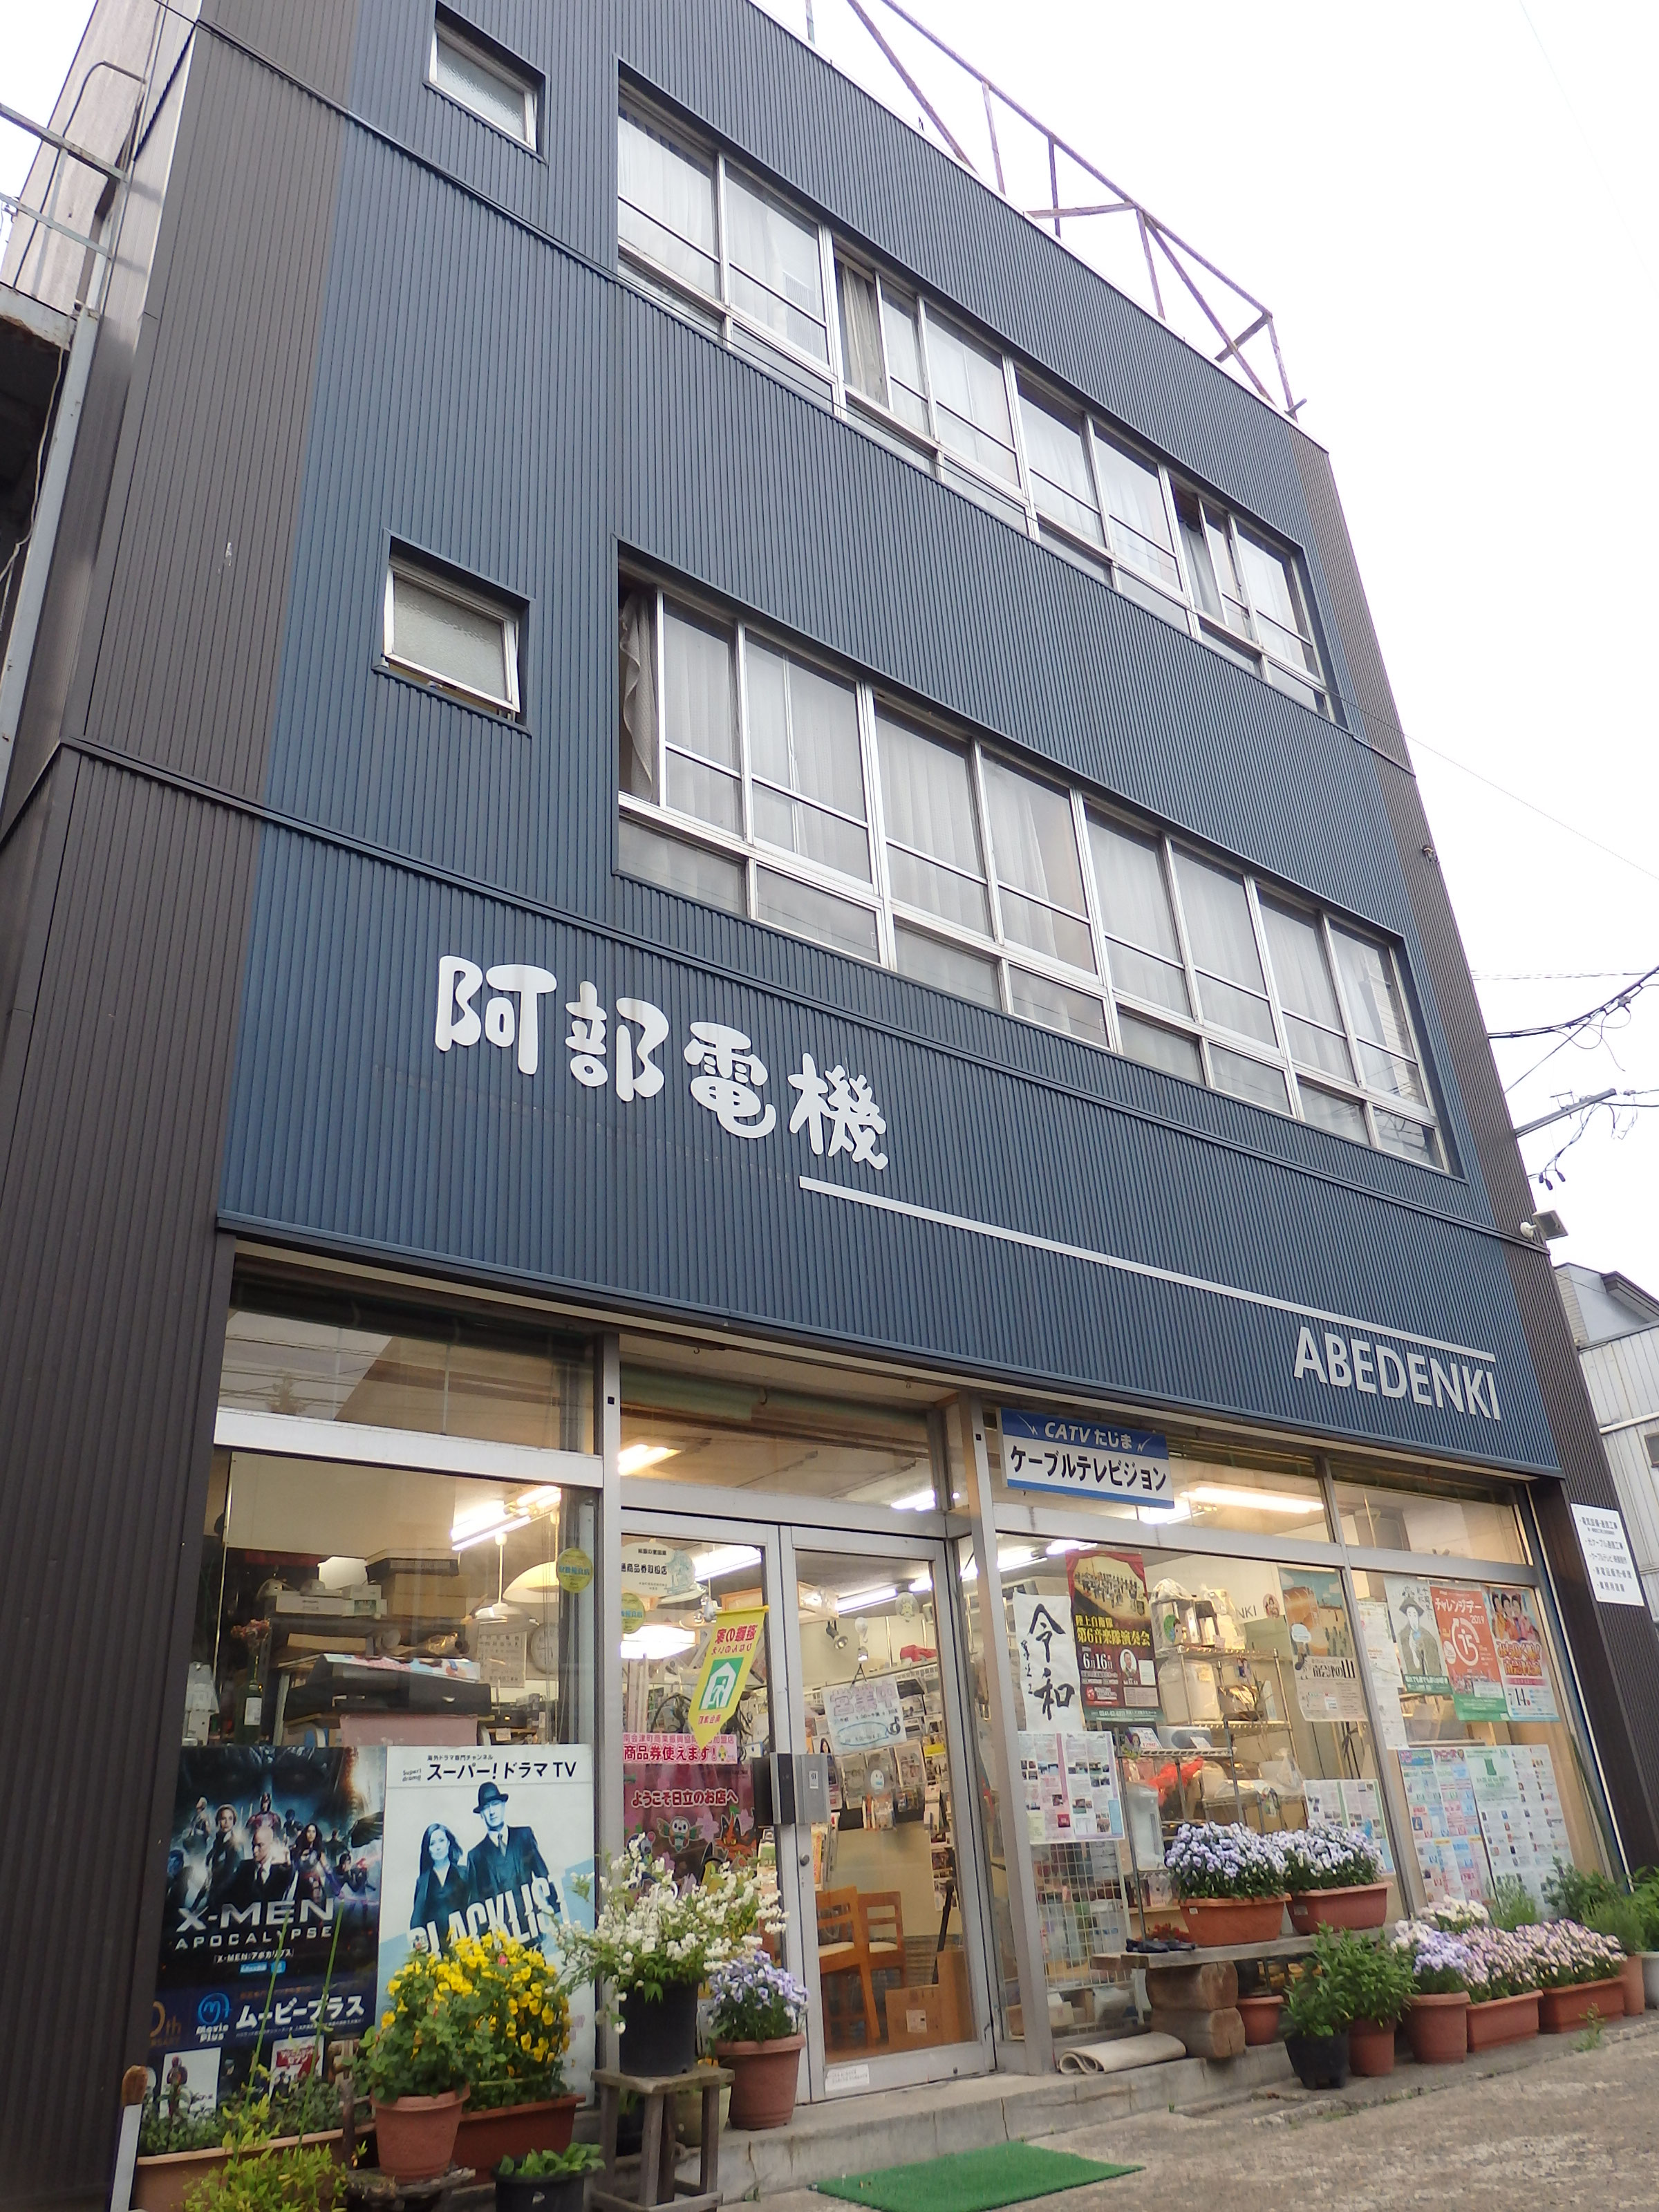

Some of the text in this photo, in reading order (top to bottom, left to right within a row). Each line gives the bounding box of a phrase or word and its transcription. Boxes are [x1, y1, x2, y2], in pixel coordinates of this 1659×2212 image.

[435, 955, 888, 1170] 阿部電機
[1293, 1327, 1501, 1421] ABEDENKI
[1011, 1445, 1166, 1492] ケーブルテレビジョン
[1435, 1597, 1482, 1613] チャレンジデー
[1470, 1615, 1485, 1624] 2019
[1027, 1603, 1076, 1721] 令和
[830, 1680, 897, 1716] 営業中
[632, 1788, 738, 1808] ようこそ日立のお店へ
[176, 1897, 334, 1933] X-MEN
[174, 1926, 332, 1951] APOCALYPSE
[235, 1995, 365, 2030] ムービープラス
